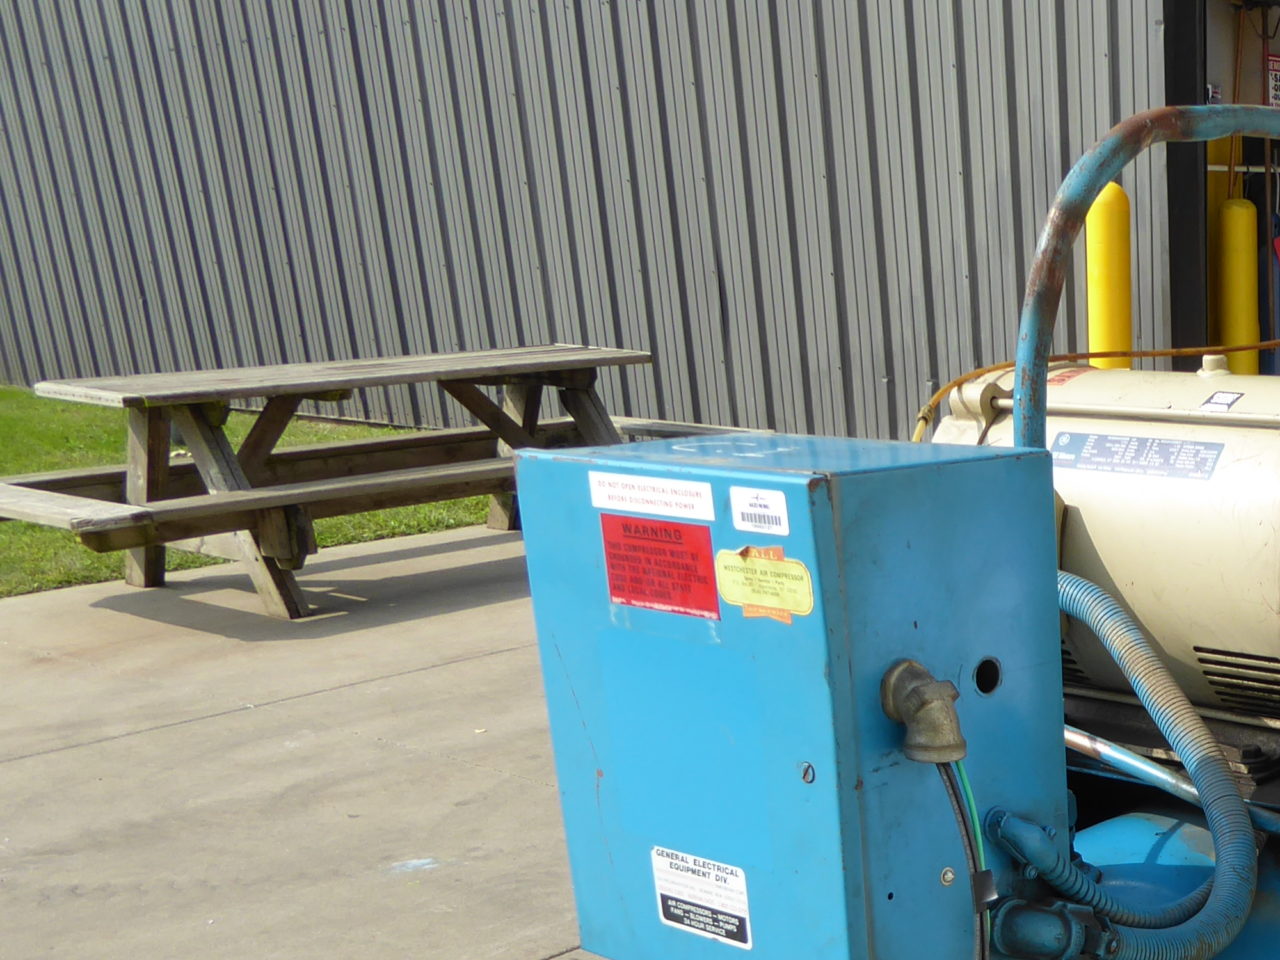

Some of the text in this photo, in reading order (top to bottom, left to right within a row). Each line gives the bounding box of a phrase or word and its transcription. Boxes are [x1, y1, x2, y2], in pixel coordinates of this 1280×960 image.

[608, 481, 619, 489] NOT
[621, 482, 636, 491] OPEN
[637, 484, 669, 495] ELECTRICAL
[674, 502, 695, 510] POWER
[622, 523, 683, 541] WARNING
[751, 548, 778, 560] ALL
[723, 564, 758, 575] WESTCHESTER
[770, 570, 804, 582] COMPRESSOR
[656, 848, 739, 878] GENERAL ELECTRICAL
[669, 861, 711, 879] EQUIPMENT
[715, 874, 730, 885] DIV.
